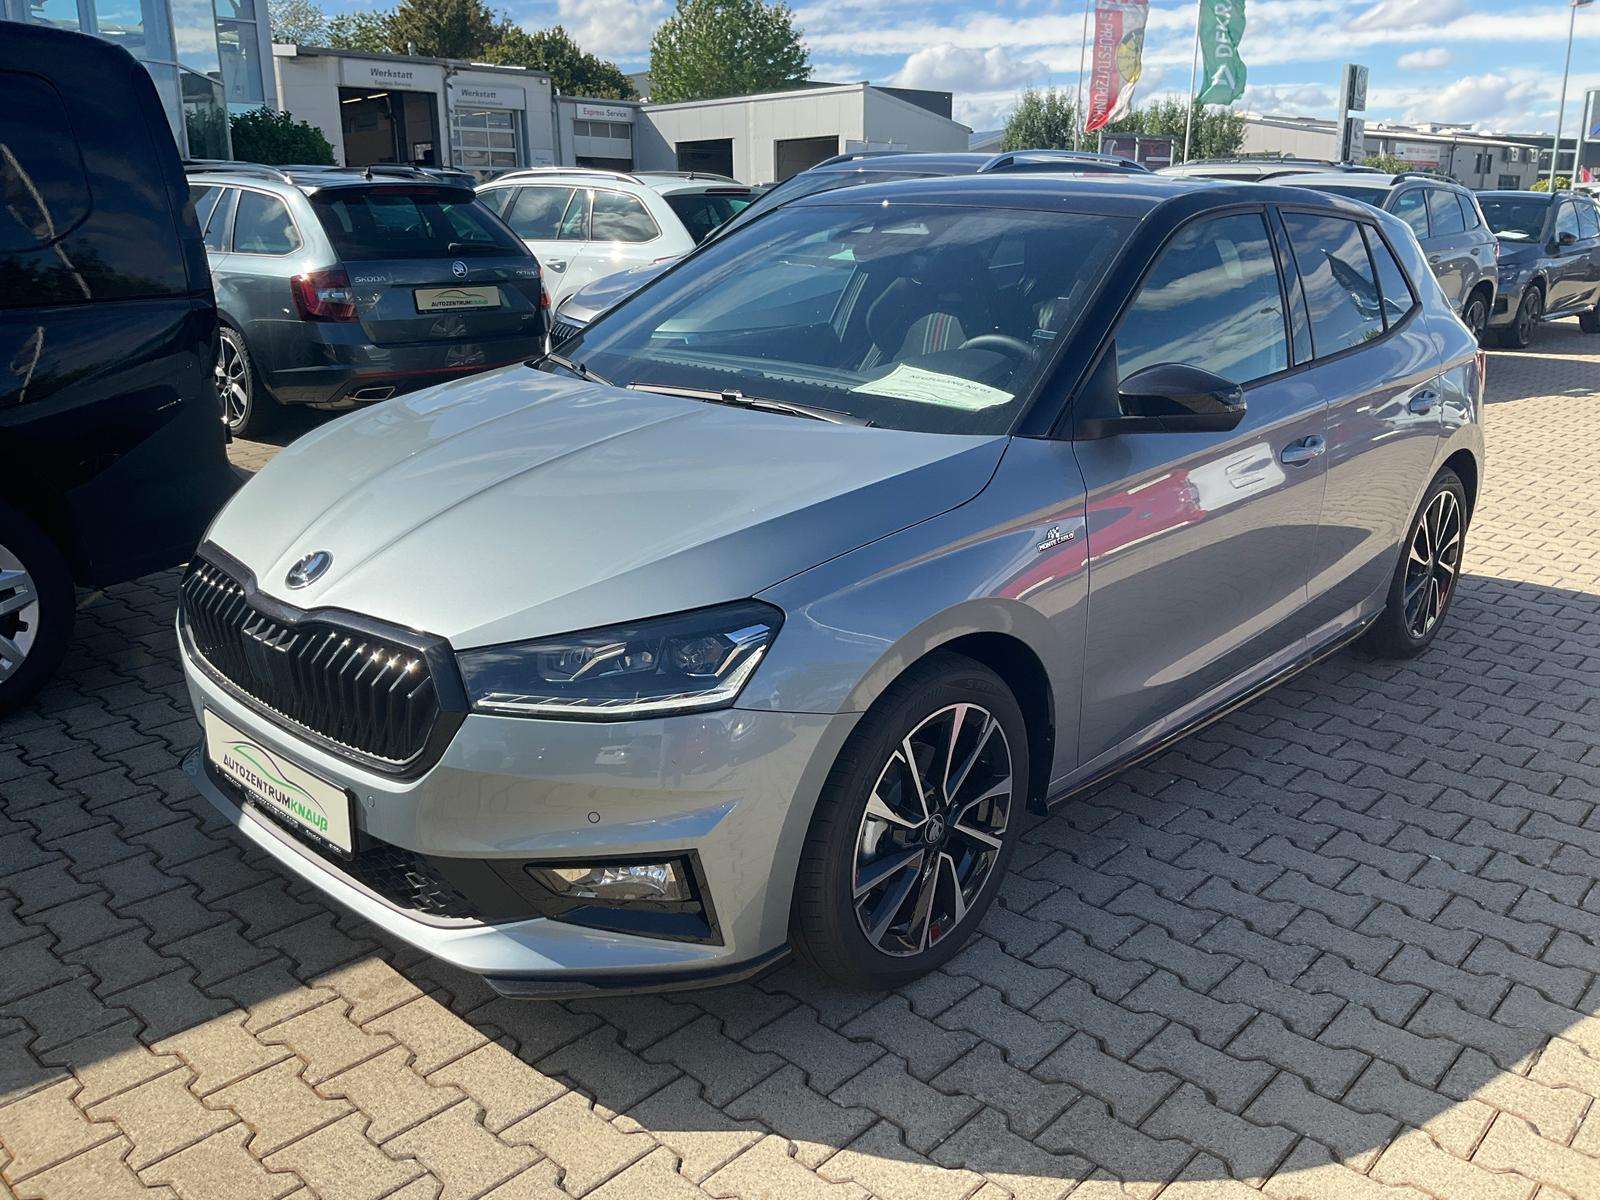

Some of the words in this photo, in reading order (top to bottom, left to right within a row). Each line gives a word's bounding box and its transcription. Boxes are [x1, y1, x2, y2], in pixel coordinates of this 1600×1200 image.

[370, 68, 414, 79] Werkstatt
[461, 89, 496, 99] Werkstatt
[583, 107, 605, 117] Express
[606, 109, 627, 118] Service
[1038, 540, 1057, 551] MONTE
[1057, 532, 1074, 544] CARLO
